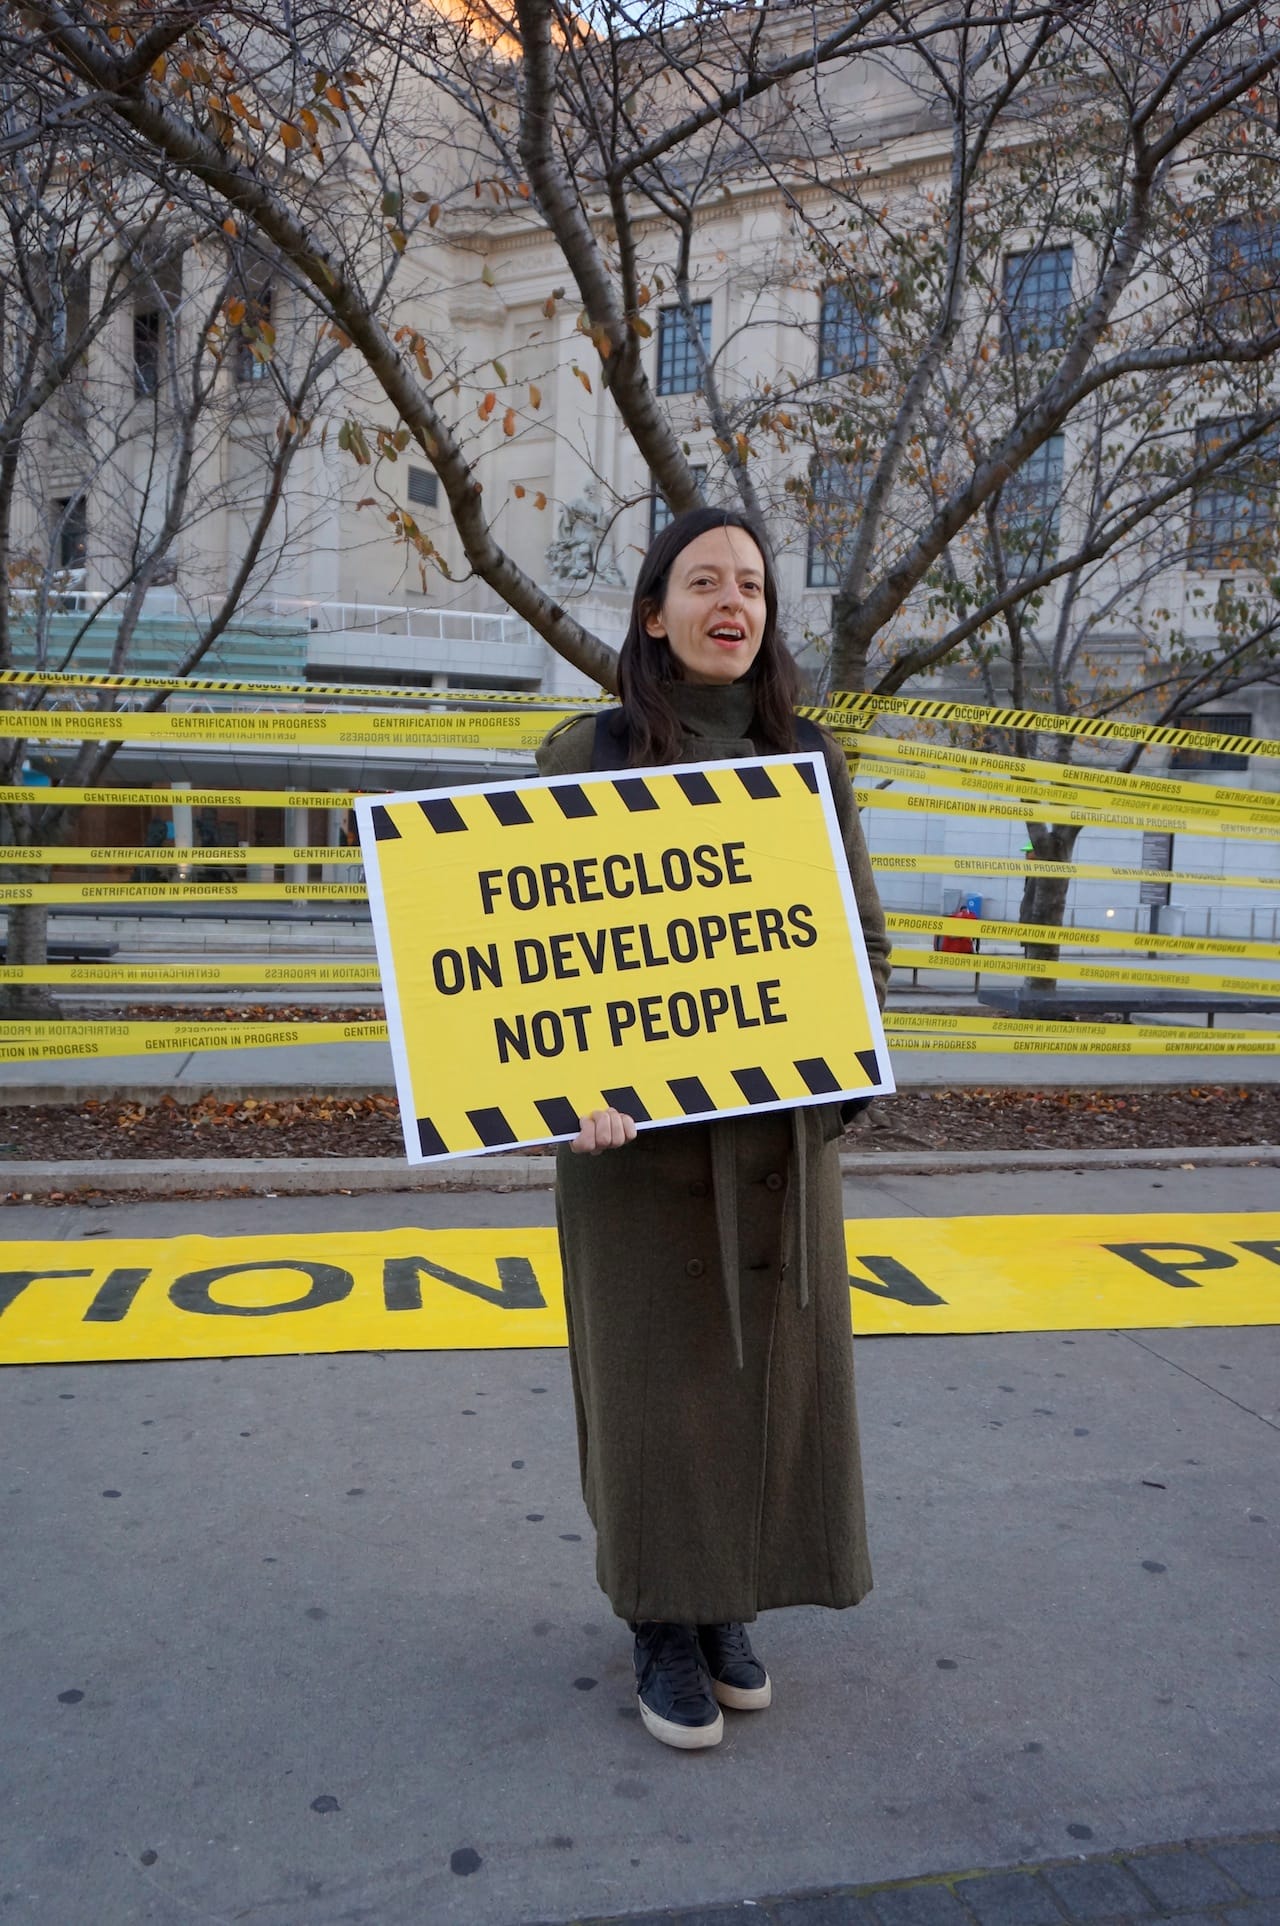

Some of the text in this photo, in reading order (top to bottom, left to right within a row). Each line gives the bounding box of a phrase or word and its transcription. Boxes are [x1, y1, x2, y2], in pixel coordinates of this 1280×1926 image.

[871, 698, 909, 712] OCCUPY
[826, 712, 864, 725] OCCUPY
[954, 707, 992, 721] OCCUPY
[0, 715, 122, 728] FICATION IN PROGRESS
[171, 717, 327, 729] GENTRIFICATION IN PROGRESS
[372, 717, 521, 729] GENTRIFICATION IN PROGRESS
[1035, 716, 1071, 730] OCCUPY
[1113, 725, 1148, 739] OCCUPY
[1188, 734, 1222, 748] OCCUPY
[898, 744, 1026, 773] GENTRIFICATION IN PROGRESS
[1062, 768, 1182, 794] GENTRIFICATION IN PROGRESS
[83, 792, 241, 804] GENTRIFICATION IN PROGRESS
[288, 796, 354, 806] GENTRIFICAT
[1215, 790, 1277, 806] GENTRIFICATION
[907, 796, 1034, 818] GENTRIFICATION IN PROGRESS
[1070, 810, 1187, 830] GENTRIFICATION IN PROGRESS
[90, 849, 247, 860] GENTRIFICATION IN PROGRESS
[293, 849, 363, 859] GENTRIFICATI
[871, 856, 917, 868] PROGRESS
[953, 859, 1077, 874] GENTRIFICATION IN PROGRESS
[479, 842, 752, 914] FORECLOSE
[81, 886, 238, 898] GENTRIFICATION IN PROGRESS
[285, 884, 366, 895] GENTRIFICATION
[887, 917, 944, 931] IN PROGRESS
[980, 924, 1100, 944] GENTRIFICATION IN PROGRESS
[433, 905, 817, 995] ON DEVELOPERS
[1134, 936, 1247, 954] GENTRIFICATION IN PROGRESS
[494, 980, 787, 1063] NOT PEOPLE
[343, 1025, 388, 1037] GENTRIFI
[145, 1031, 299, 1050] GENTRIFICATION IN PROGRESS
[921, 1040, 931, 1049] IN
[932, 1040, 977, 1051] PROGRESS
[1013, 1041, 1132, 1053] GENTRIFICATION IN PROGRESS
[0, 1043, 98, 1058] TION IN PROGRESS
[1165, 1043, 1276, 1053] GENTRIFICATION IN PROGRESS
